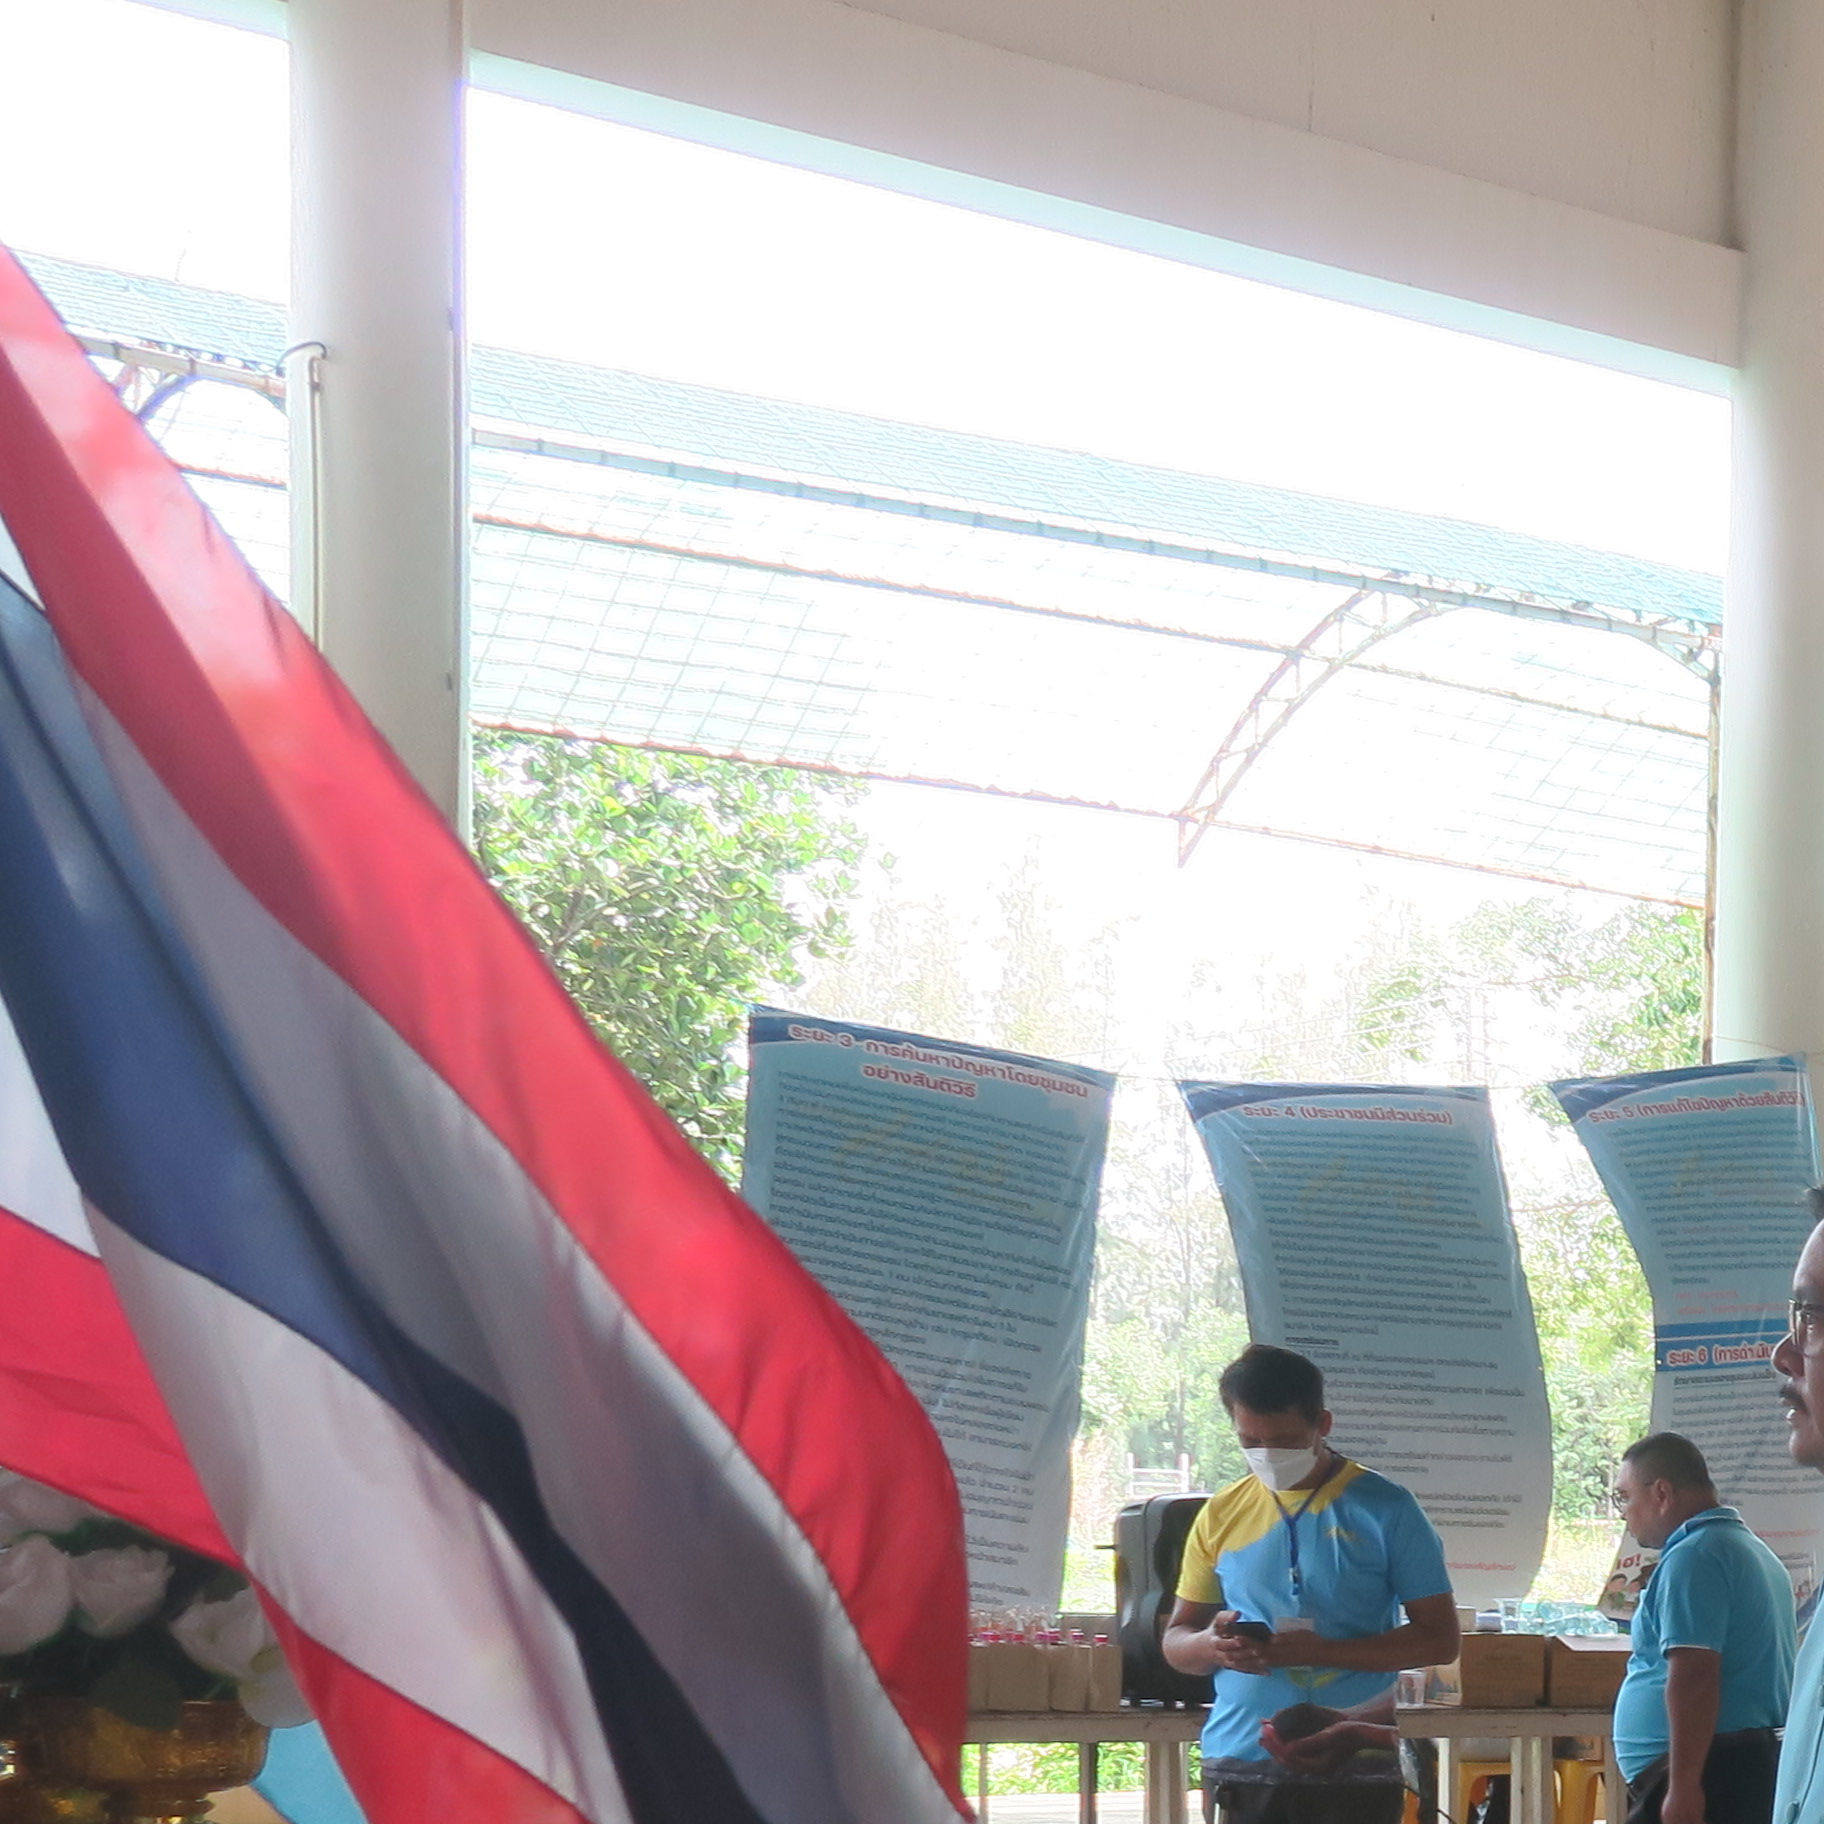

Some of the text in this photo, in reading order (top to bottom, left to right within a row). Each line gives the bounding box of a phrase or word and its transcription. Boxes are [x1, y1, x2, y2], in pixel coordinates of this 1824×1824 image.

[789, 1024, 834, 1044] ระยะ
[839, 1033, 854, 1048] 3
[1243, 1105, 1280, 1118] ระยะ
[1283, 1106, 1296, 1118] 4
[1588, 1109, 1621, 1123] ระยะ
[1623, 1105, 1635, 1118] 5
[1668, 1351, 1695, 1365] ระยะ
[1697, 1347, 1707, 1363] 6
